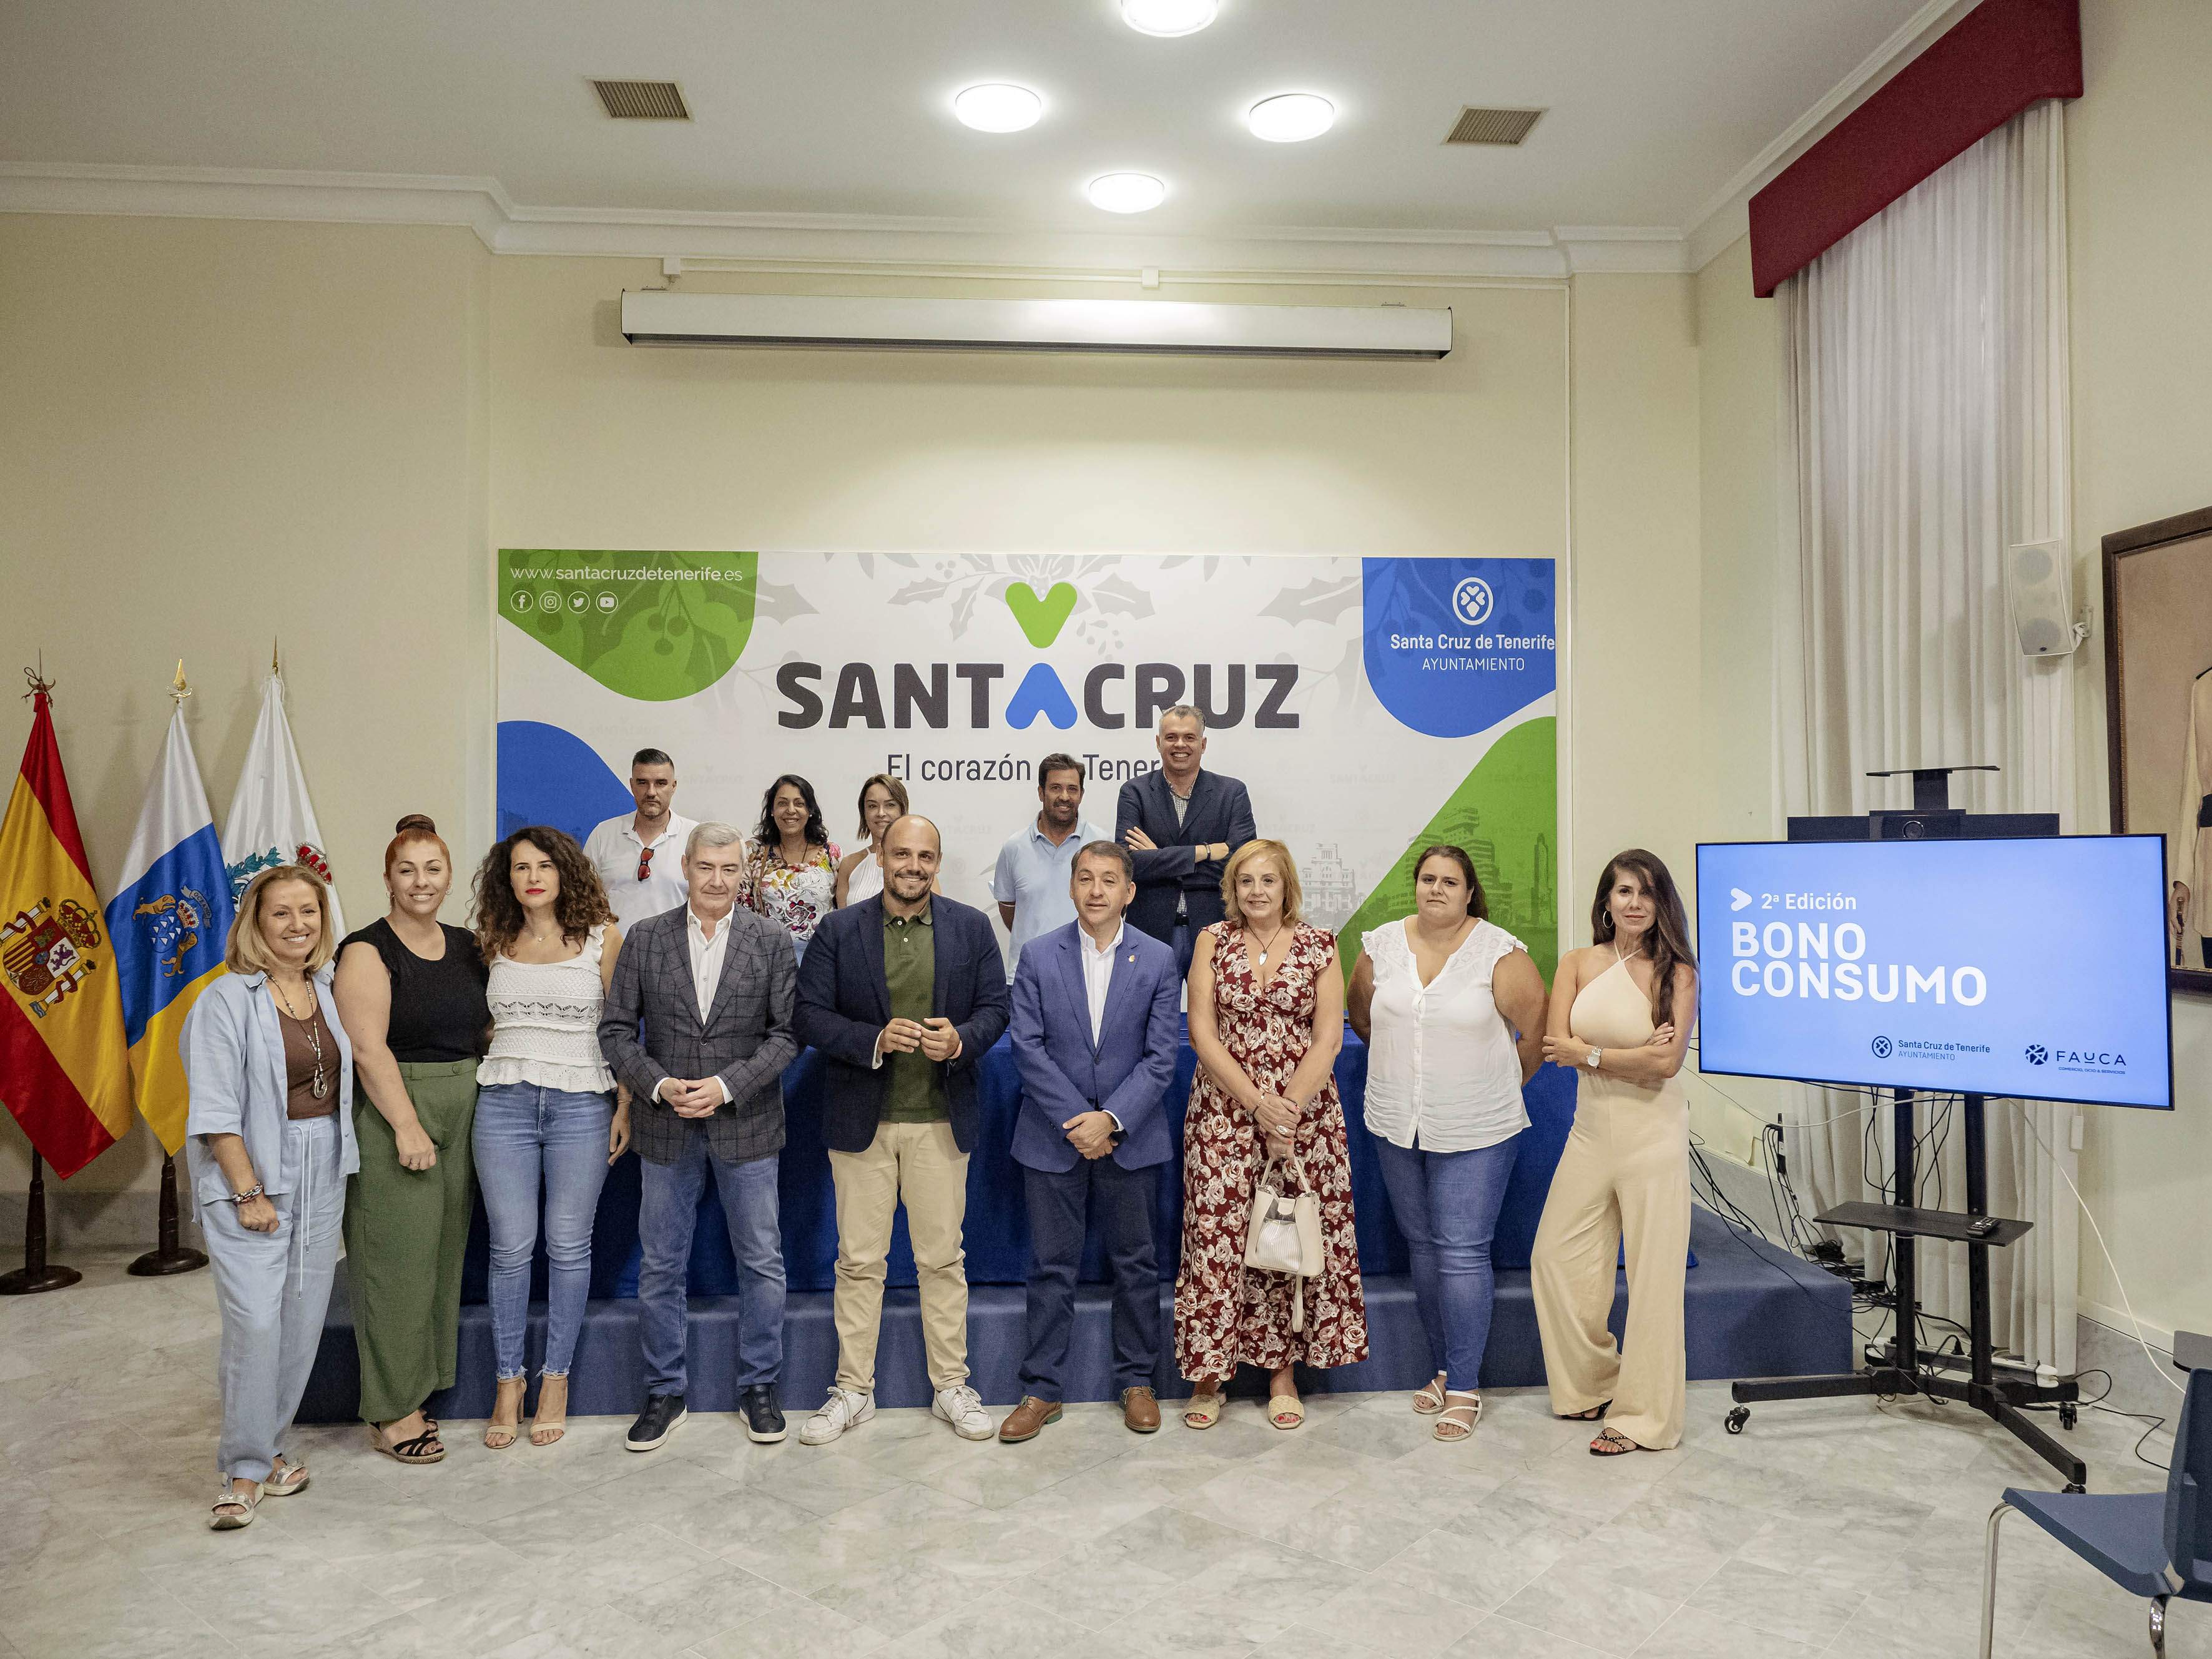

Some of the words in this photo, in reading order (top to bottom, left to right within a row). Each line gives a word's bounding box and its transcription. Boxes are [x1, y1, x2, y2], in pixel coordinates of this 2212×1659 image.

[510, 566, 743, 581] www.santacruzdetenerife.es
[1390, 634, 1433, 649] Santa
[1438, 634, 1472, 649] Cruz
[1475, 634, 1493, 649] de
[1496, 634, 1555, 651] Tenerife
[1422, 657, 1525, 671] AYUNTAMIENTO
[888, 753, 910, 780] El
[921, 753, 1031, 781] corazón
[1083, 754, 1160, 780] Tener
[1761, 892, 1779, 910] 2ª
[1786, 892, 1857, 910] Edición
[1732, 921, 1867, 961] BONO
[1731, 959, 1987, 1007] CONSUMO
[1898, 1040, 1922, 1049] Santa
[1924, 1041, 1943, 1050] Cruz
[1944, 1043, 1954, 1051] de
[1955, 1043, 1990, 1053] Tenerife
[1898, 1050, 1955, 1061] AYUNTAMIENTO
[2057, 1050, 2126, 1066] FAUCA
